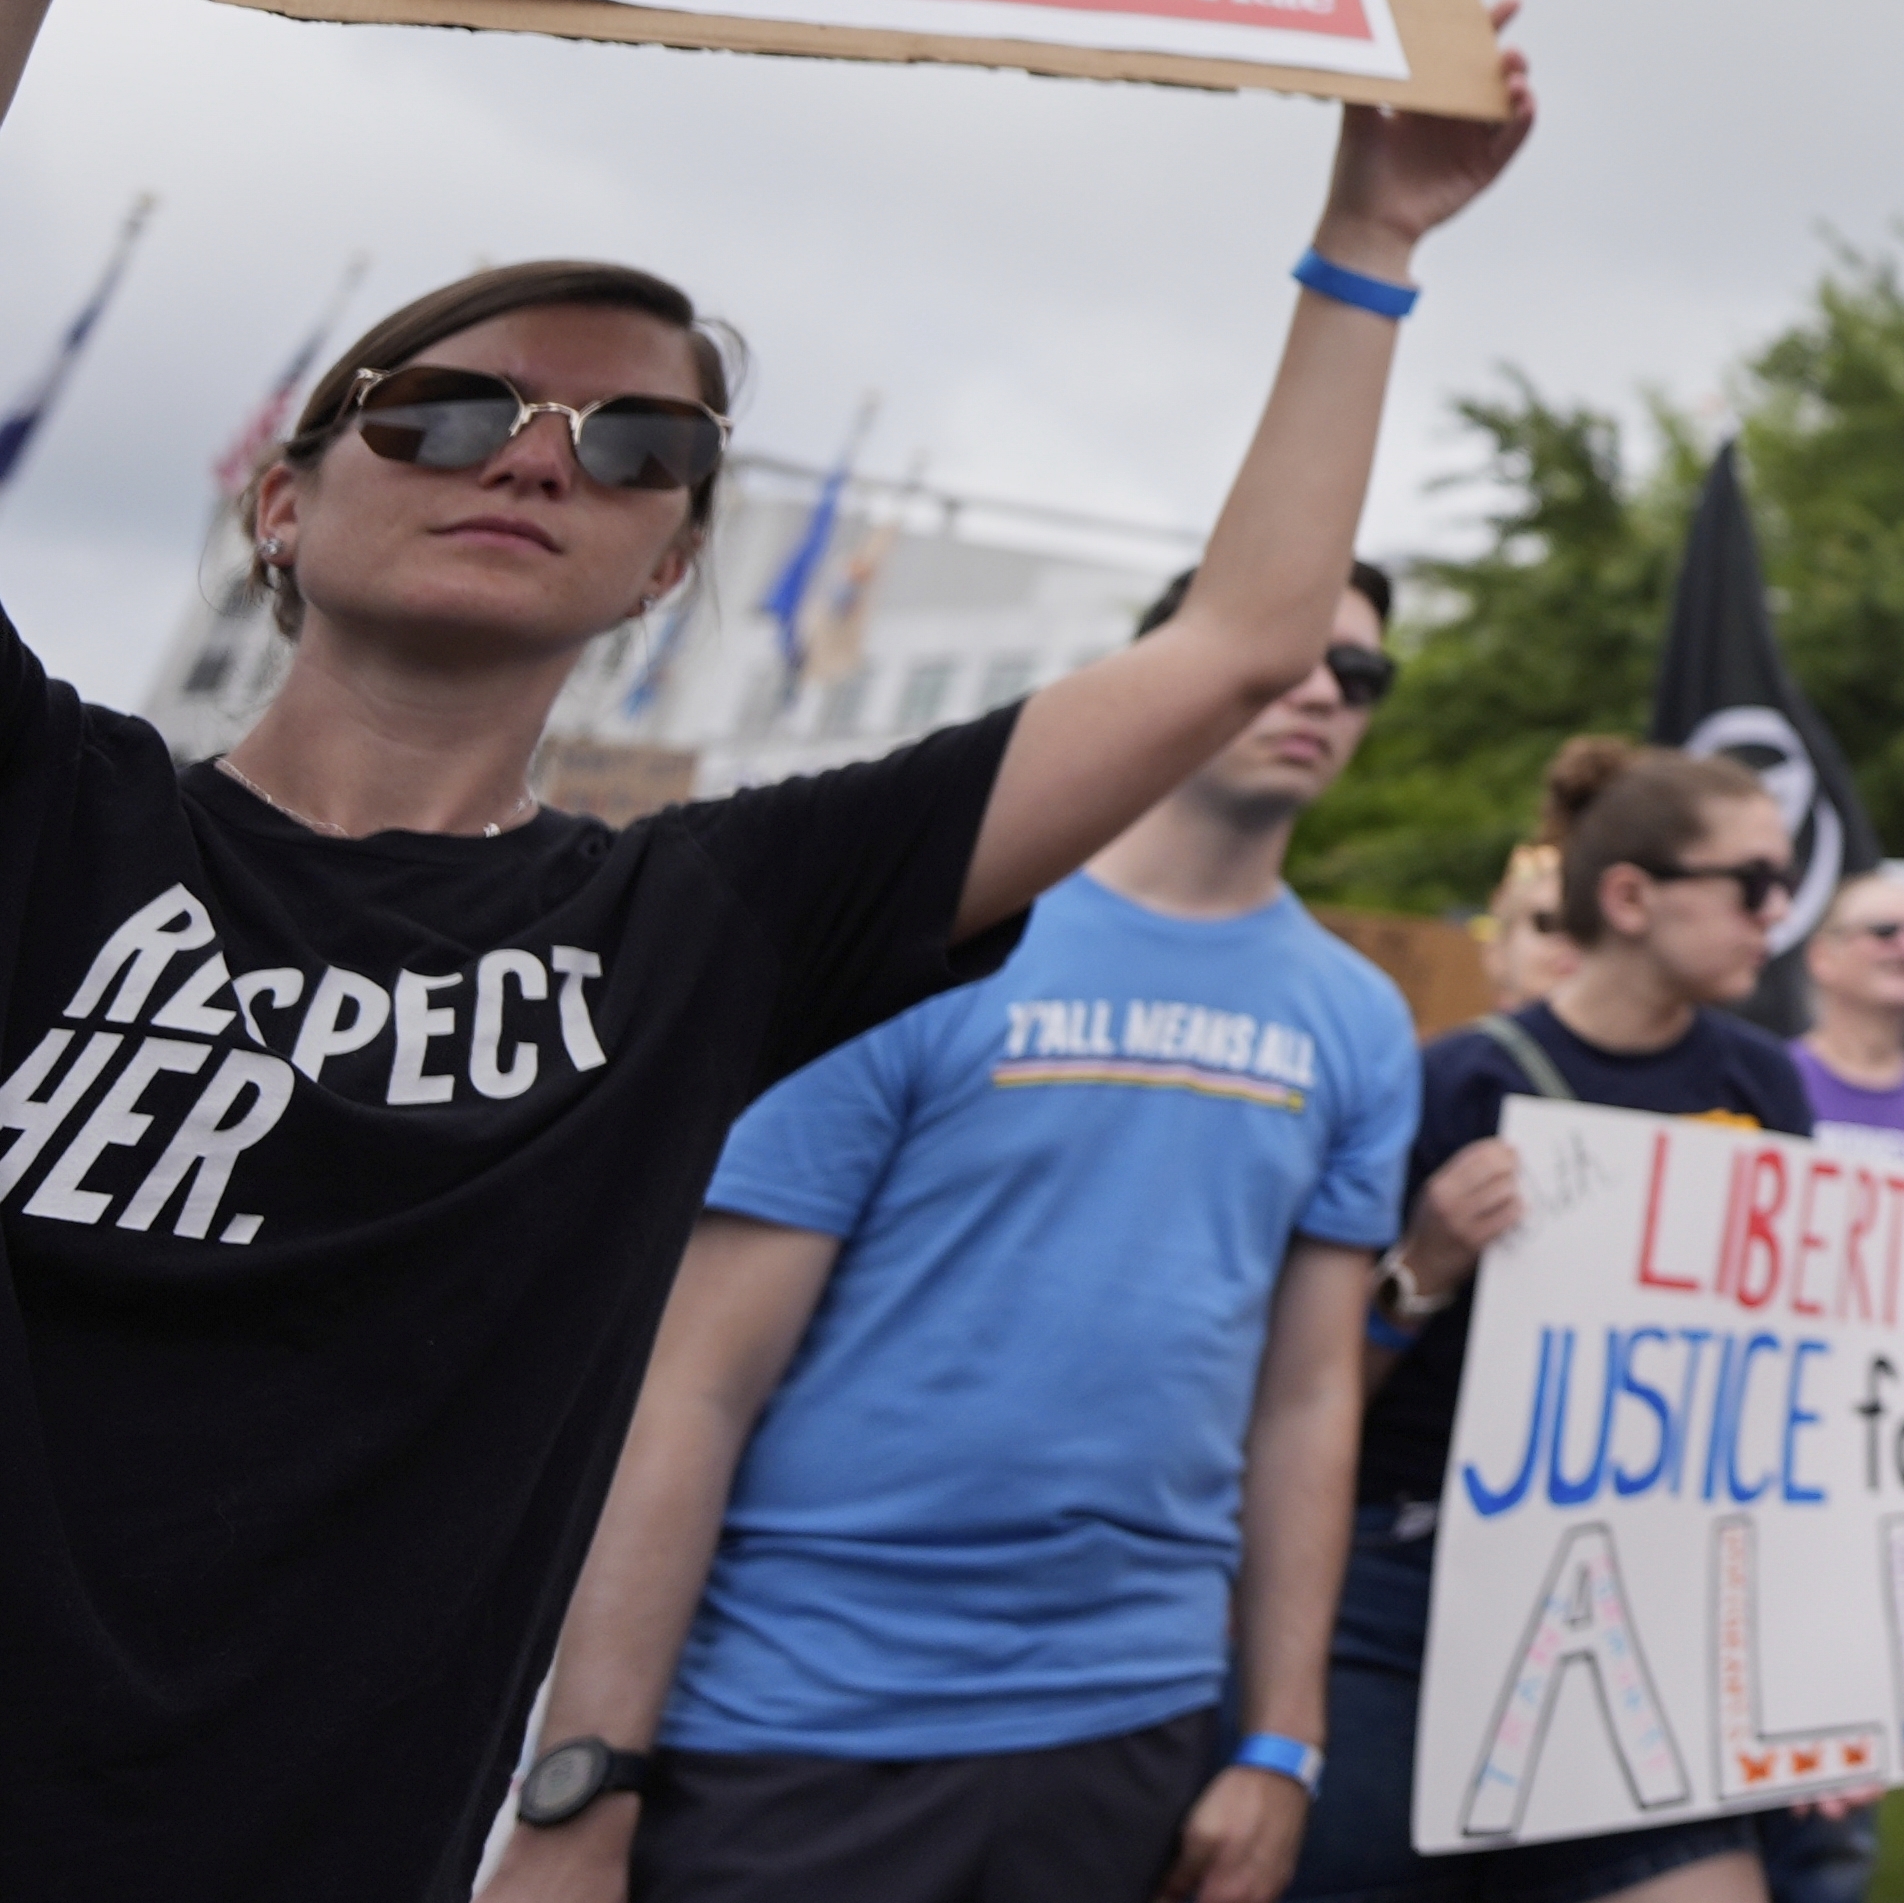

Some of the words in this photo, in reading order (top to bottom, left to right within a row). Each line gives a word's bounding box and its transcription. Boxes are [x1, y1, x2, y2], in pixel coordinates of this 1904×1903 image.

[0, 1028, 294, 1244] HER.
[1123, 998, 1257, 1070] MEANS
[1255, 1020, 1316, 1088] ALL
[1460, 1323, 1835, 1519] JUSTICE
